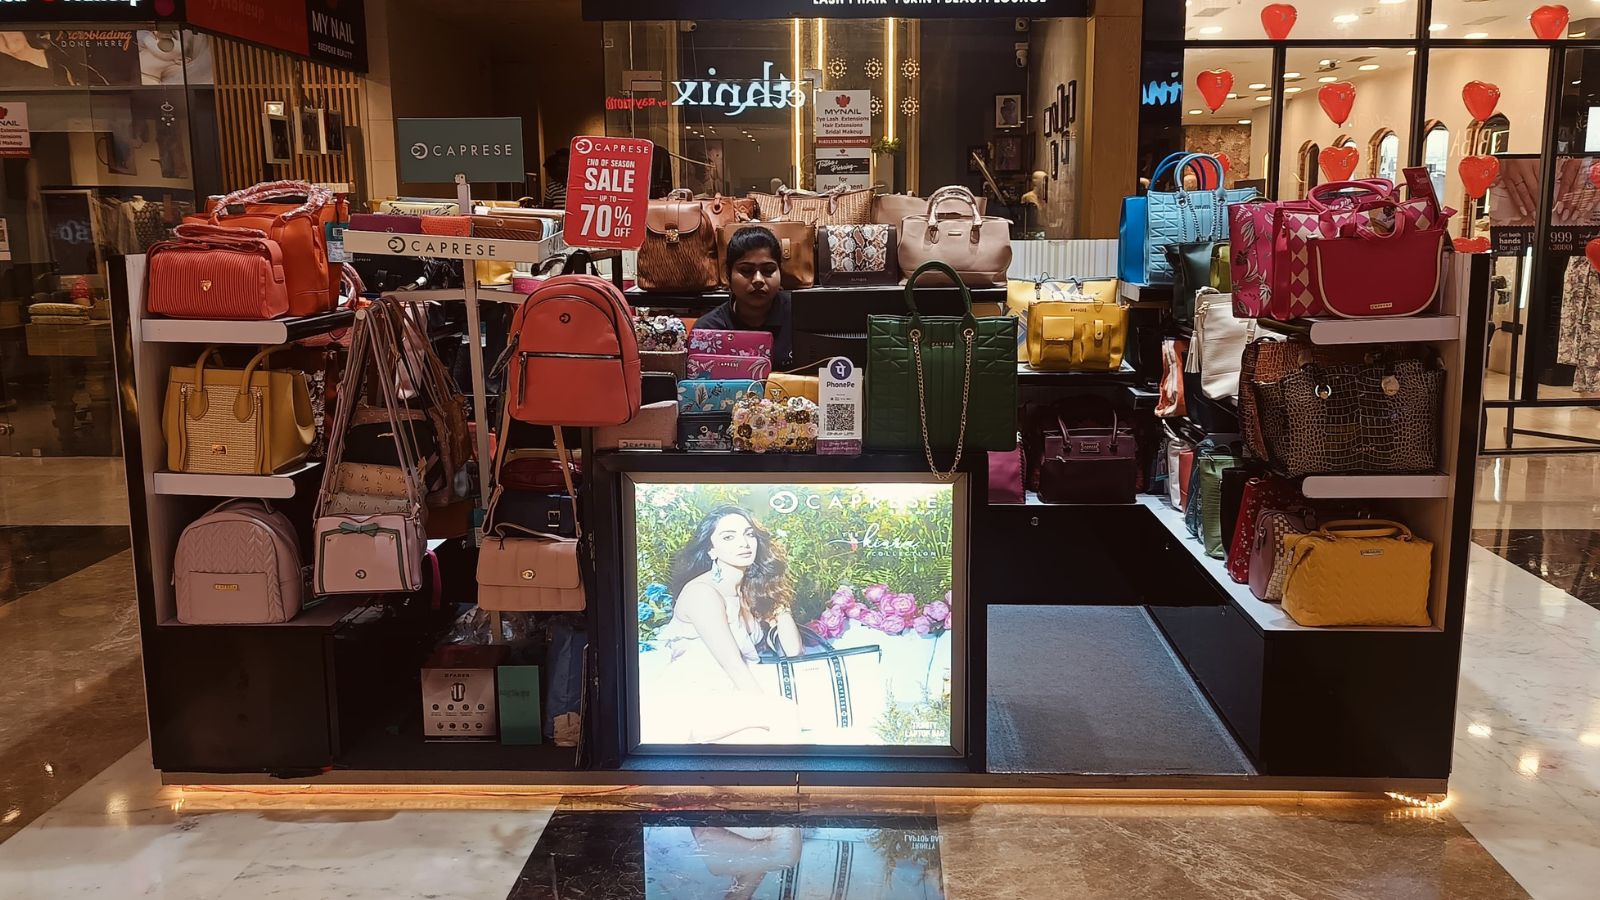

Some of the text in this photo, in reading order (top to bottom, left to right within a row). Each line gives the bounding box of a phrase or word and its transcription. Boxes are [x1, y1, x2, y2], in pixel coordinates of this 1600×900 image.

[311, 10, 328, 35] MY
[331, 20, 355, 44] NAIL
[61, 40, 91, 48] DONE
[432, 144, 513, 157] CAPRESE
[594, 143, 649, 154] CAPRESE
[587, 158, 636, 168] END OF SEASON
[584, 167, 636, 193] SALE
[599, 195, 617, 203] UP TO
[614, 227, 632, 238] OFF
[410, 239, 497, 258] CAPRESE
[805, 493, 937, 510] CAPRESE
